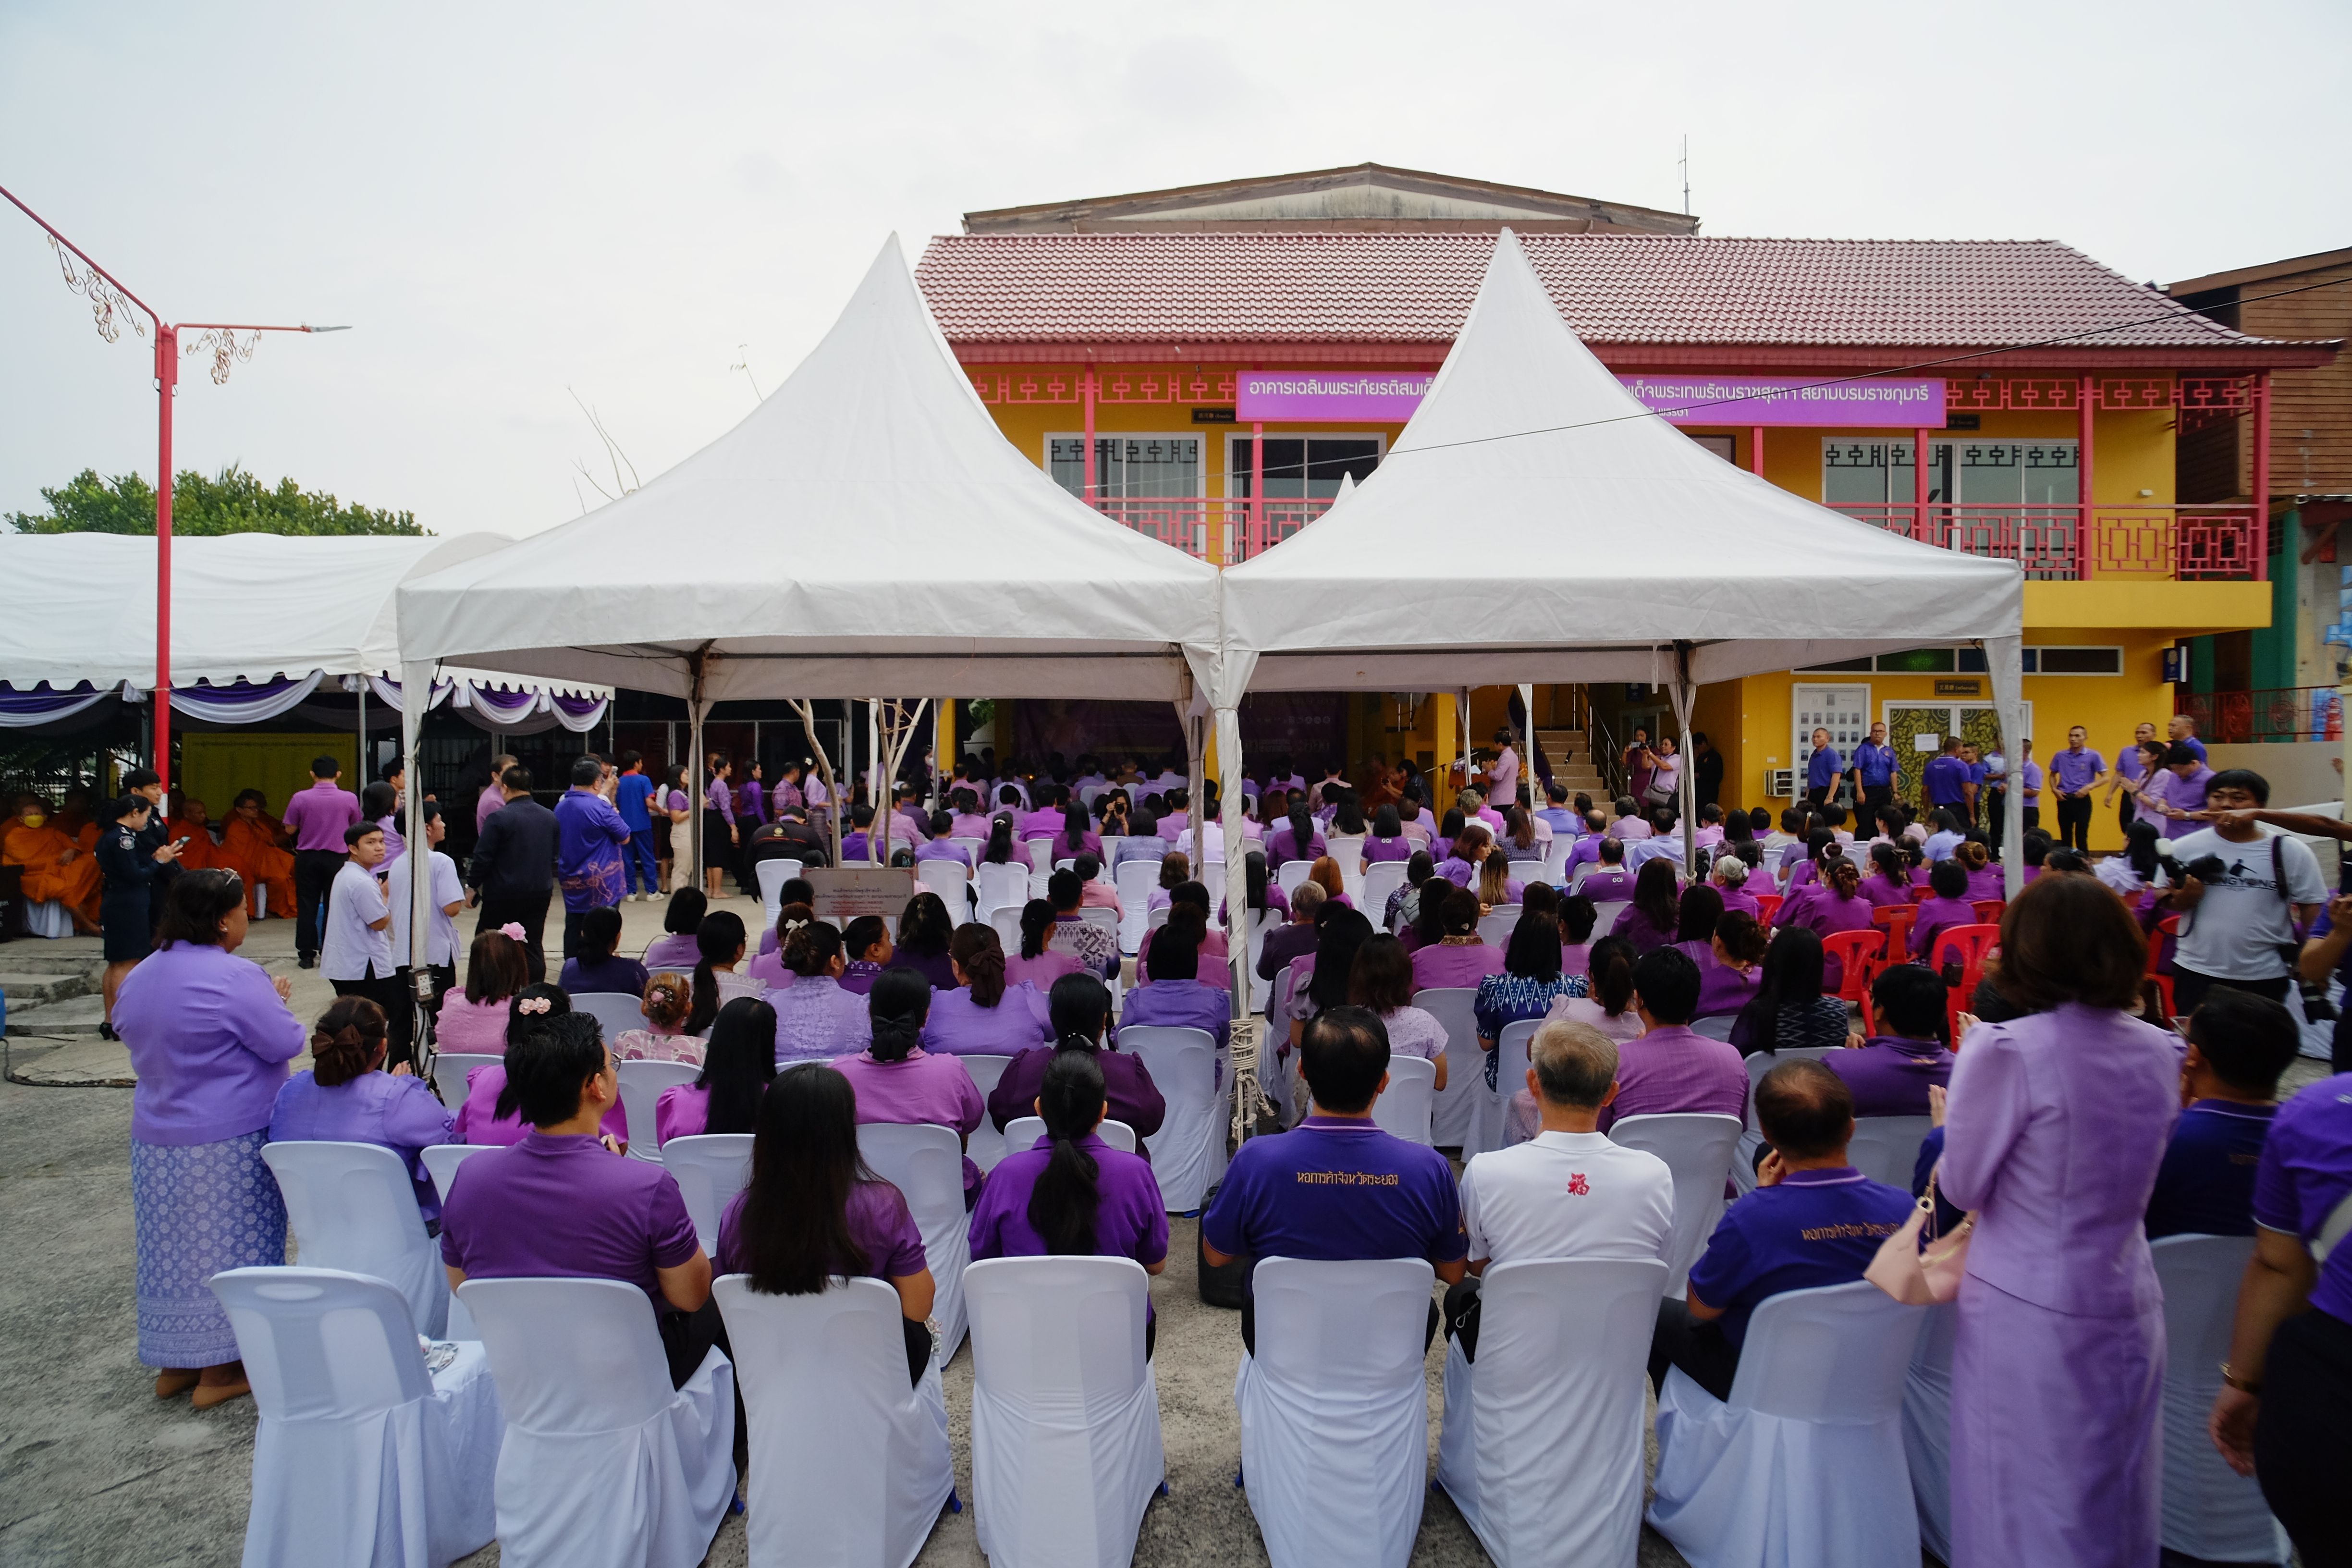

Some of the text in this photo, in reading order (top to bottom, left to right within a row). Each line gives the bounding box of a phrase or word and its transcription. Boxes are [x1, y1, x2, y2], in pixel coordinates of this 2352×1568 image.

[1801, 384, 1929, 406] สยามบรมราชกุมารี
[1296, 1170, 1399, 1186] หอการค้าจังหวัดระยอง
